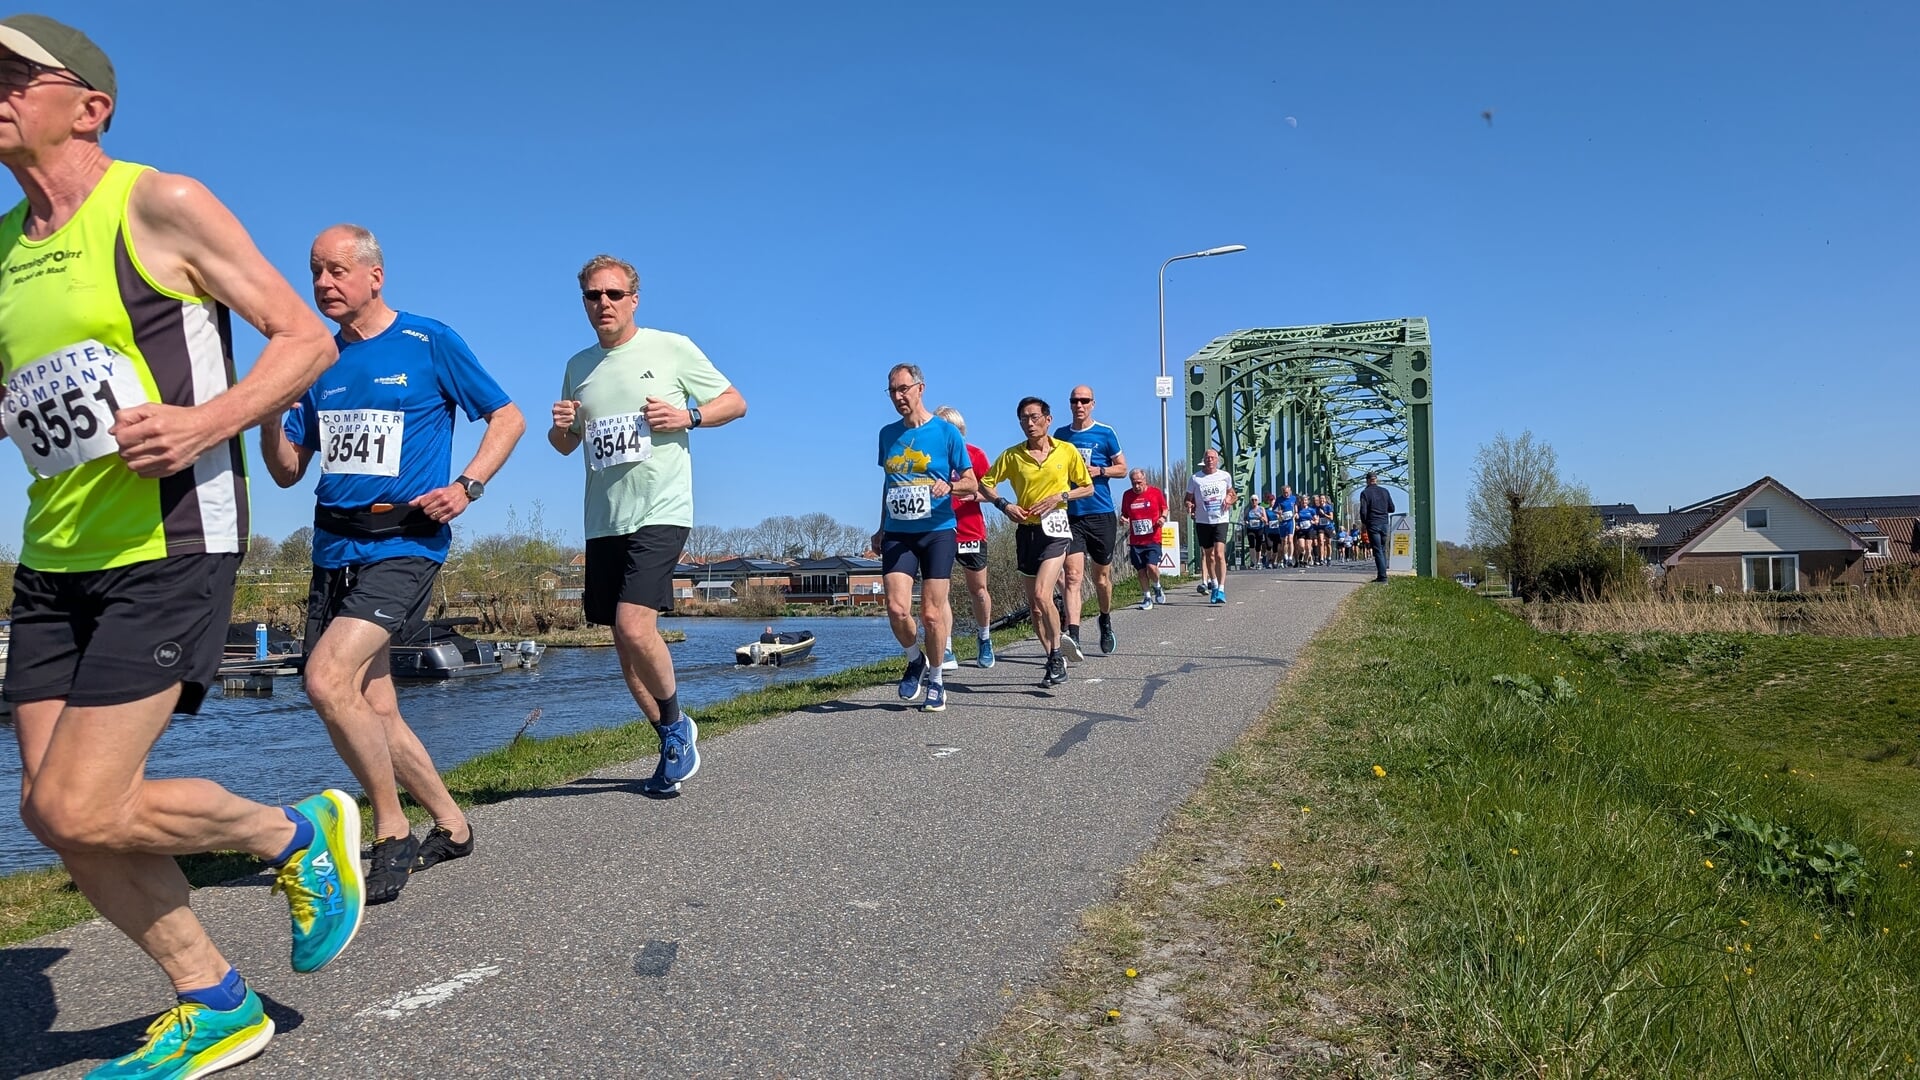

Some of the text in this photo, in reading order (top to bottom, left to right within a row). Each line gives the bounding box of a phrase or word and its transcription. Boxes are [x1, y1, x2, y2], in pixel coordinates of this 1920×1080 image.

[9, 345, 118, 391] OMPUTE
[8, 362, 114, 413] COMPANY
[18, 379, 120, 457] 3551
[322, 413, 401, 424] COMPUTER
[329, 424, 394, 434] COMPANY
[587, 414, 647, 431] COMPUTER
[590, 423, 643, 438] COMPANY
[328, 433, 386, 464] 3541
[593, 431, 641, 460] 3544
[1203, 487, 1220, 497] 3549
[891, 498, 926, 514] 3542
[311, 850, 345, 916] HOKA
